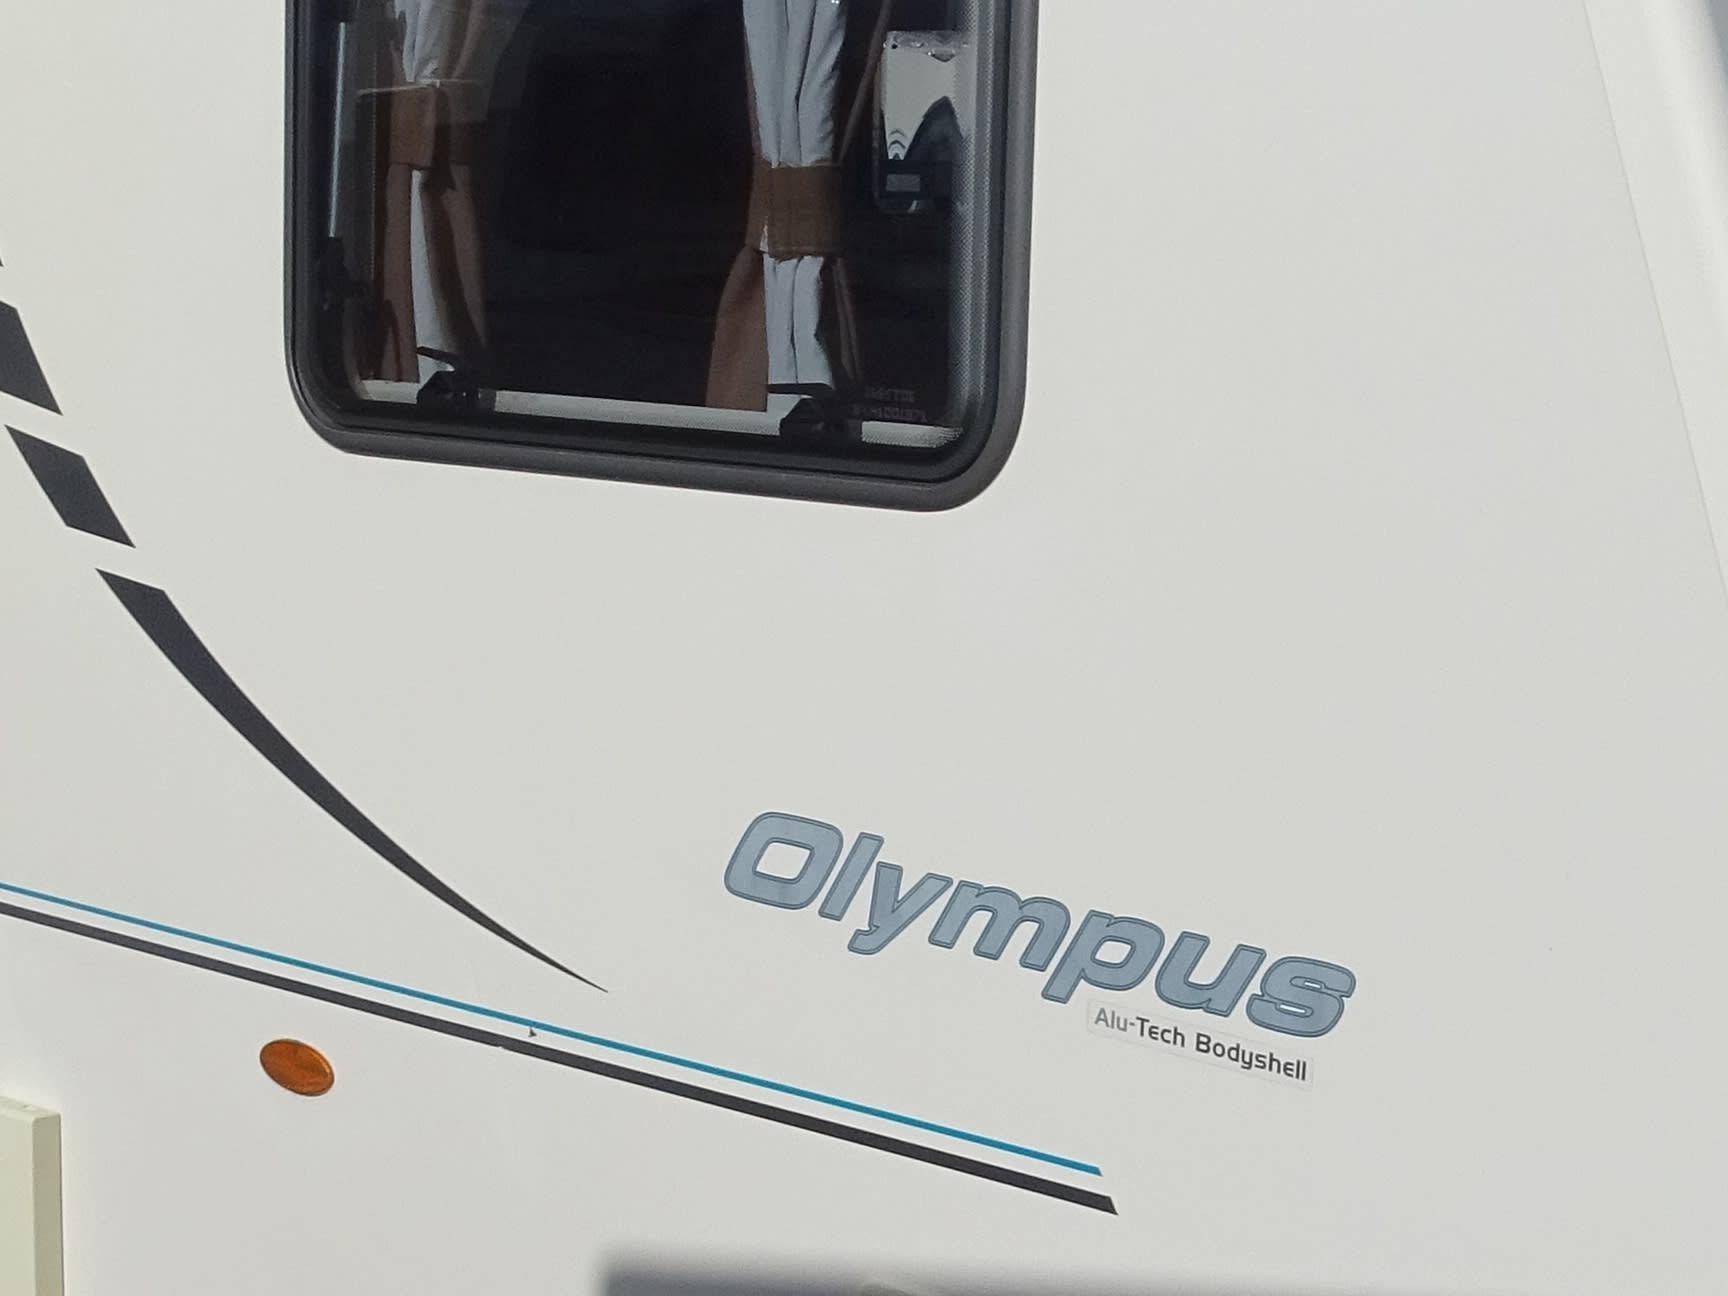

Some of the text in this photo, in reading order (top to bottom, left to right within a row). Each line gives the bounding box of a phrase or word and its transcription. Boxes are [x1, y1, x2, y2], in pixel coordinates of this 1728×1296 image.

[724, 811, 1357, 1038] Olympus
[1094, 1007, 1307, 1081] Alu-Tech Bodyshell
